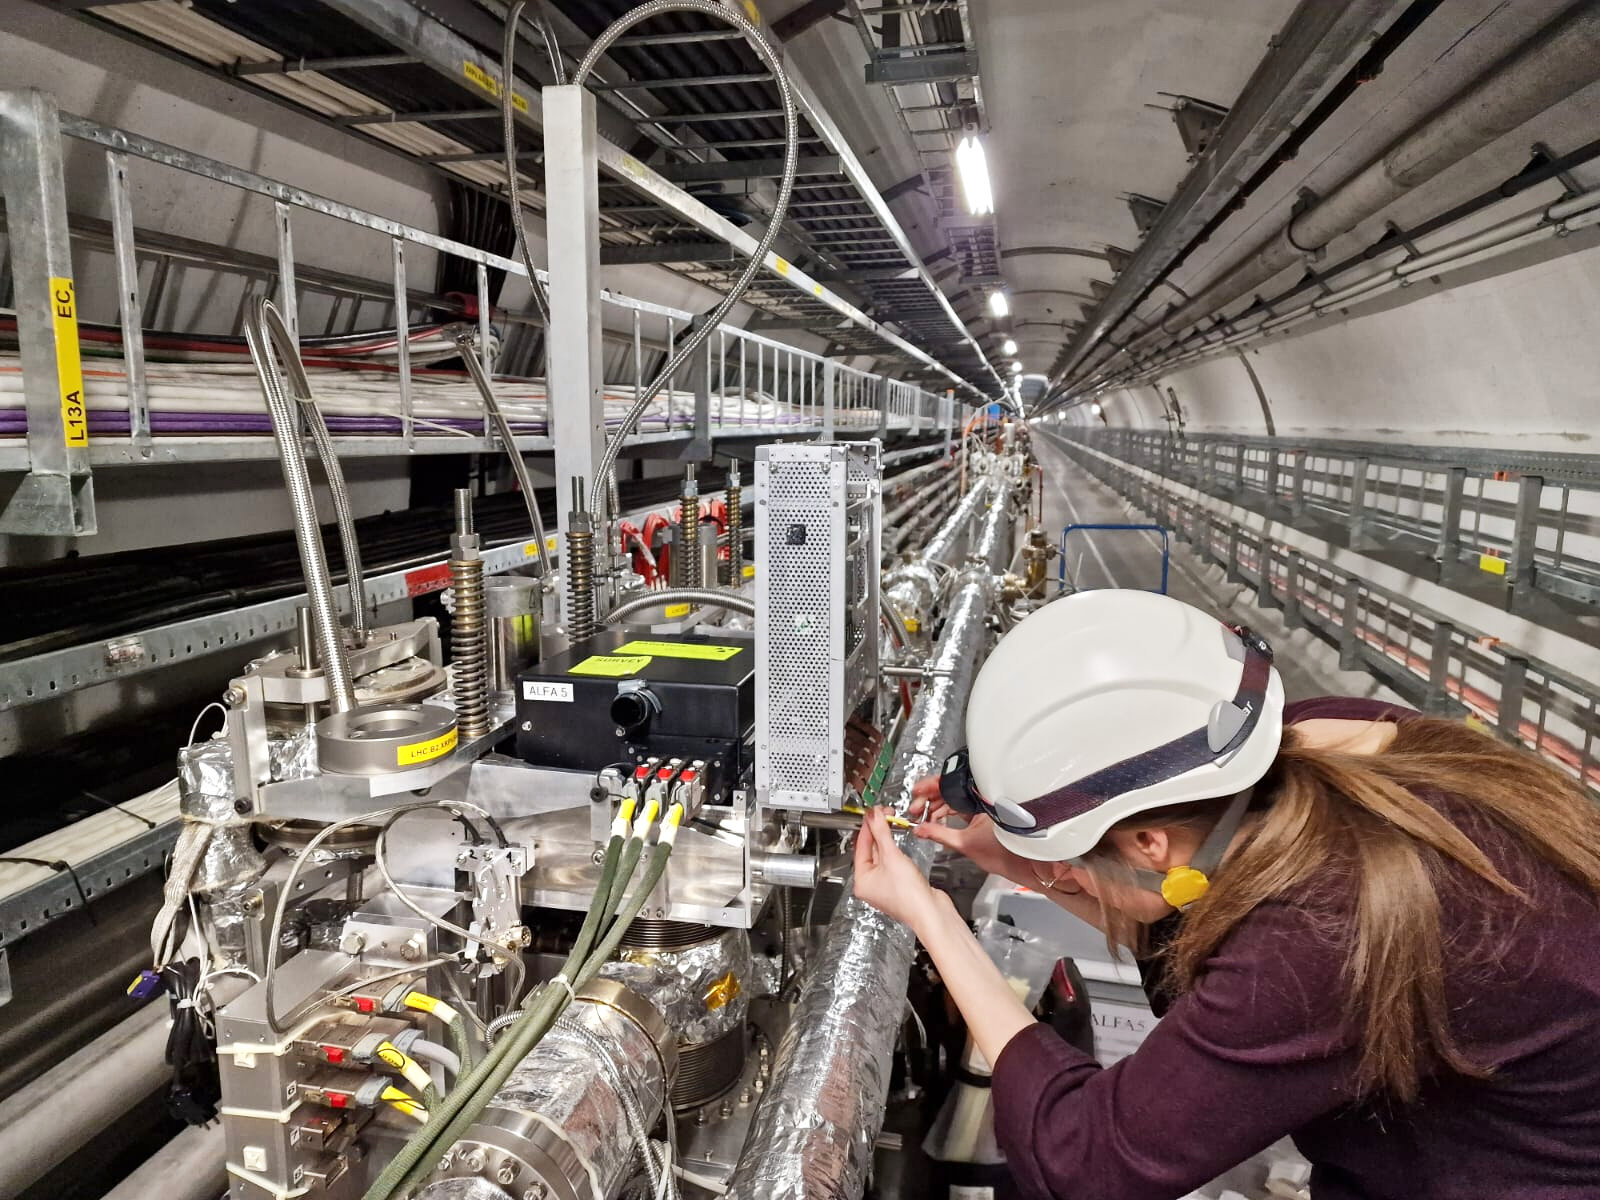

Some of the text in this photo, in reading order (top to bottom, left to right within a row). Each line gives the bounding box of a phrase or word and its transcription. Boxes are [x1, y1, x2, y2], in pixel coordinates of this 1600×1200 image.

[66, 390, 85, 441] L13A
[529, 685, 568, 698] ALFA 5
